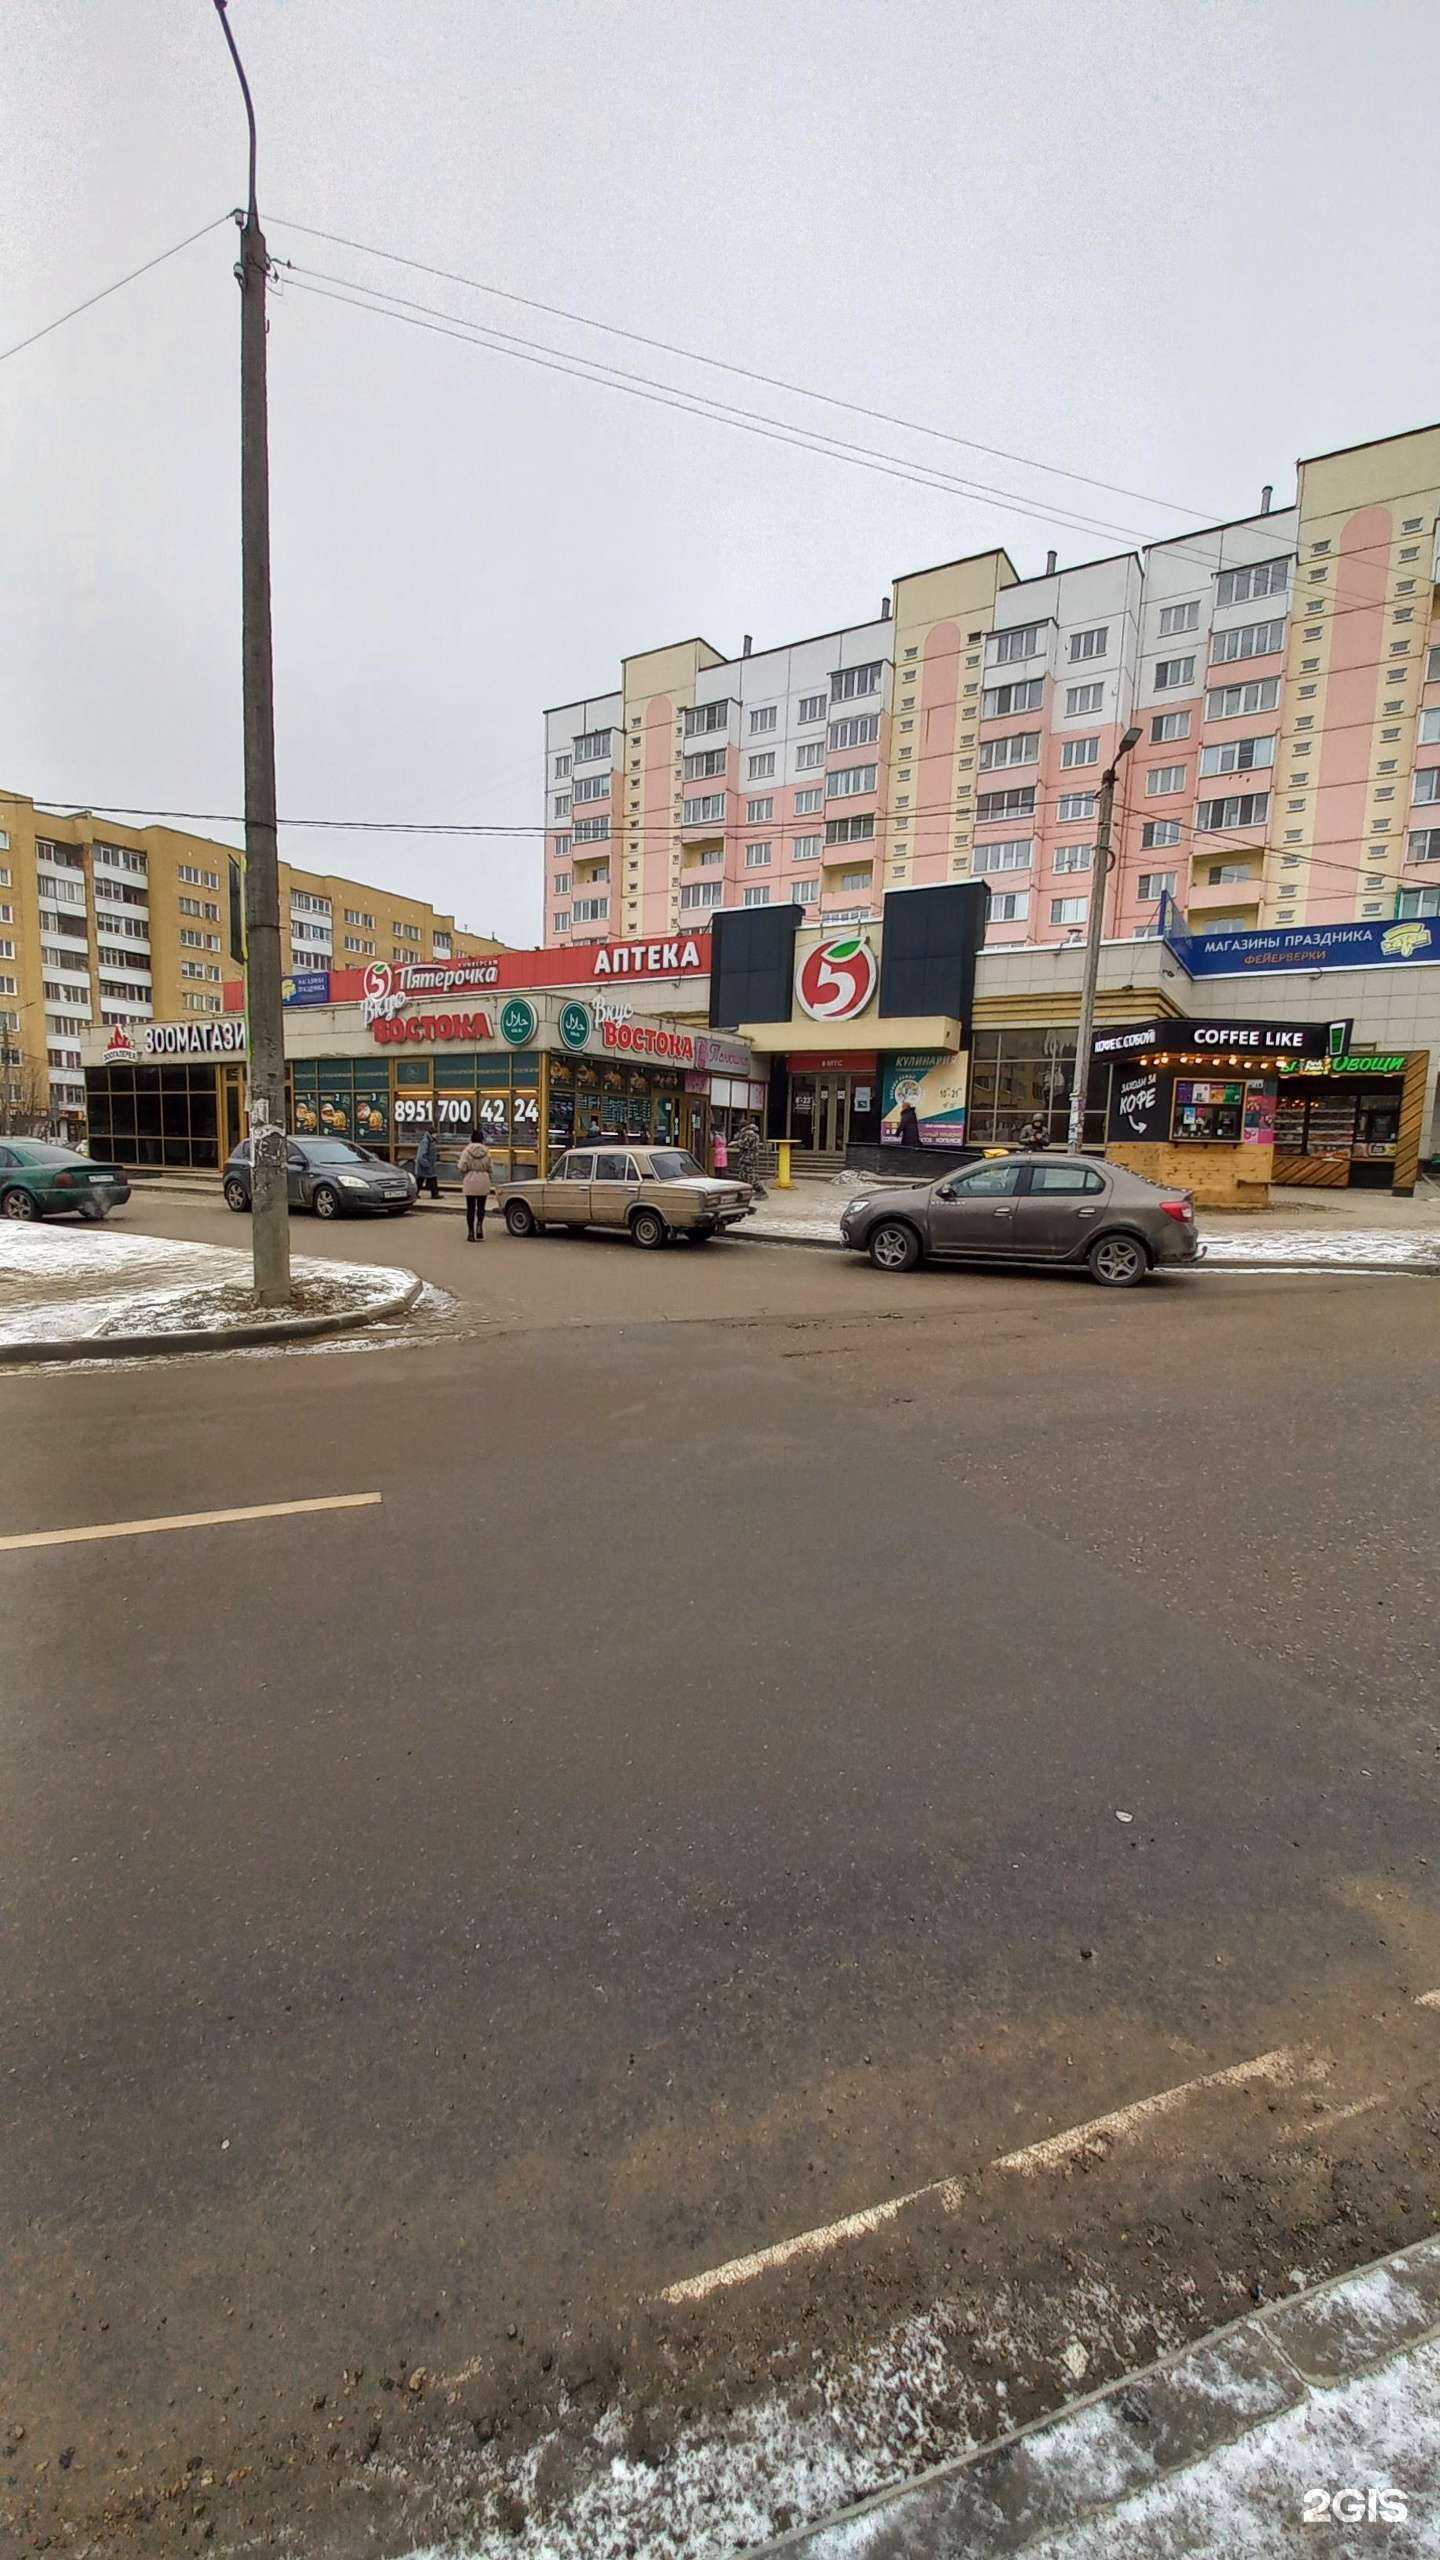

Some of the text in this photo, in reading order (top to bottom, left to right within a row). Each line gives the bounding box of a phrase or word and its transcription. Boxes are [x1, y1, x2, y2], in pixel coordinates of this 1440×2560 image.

[1204, 937, 1280, 953] МАГАЗИНЫ
[1284, 929, 1373, 948] ПРАЗДНИКА
[593, 941, 700, 975] АПТЕКА
[1243, 950, 1327, 966] ФЕЙЕРВЕРКИ
[811, 961, 856, 1017] 5
[361, 991, 406, 1027] Вкус
[591, 995, 634, 1030] Вкус
[144, 1022, 247, 1053] ЗООМАГАЗИ
[372, 1012, 494, 1045] ВОСТОКА
[602, 1022, 695, 1061] ВОСТОКА
[1094, 1039, 1116, 1053] КОФЕ
[1123, 1028, 1156, 1048] СОБОЙ
[1193, 1029, 1304, 1047] COFFEE LIKE
[895, 1055, 961, 1067] КУЛИНАРИЯ
[394, 1099, 433, 1122] 8951
[437, 1099, 472, 1123] 700
[480, 1099, 505, 1122] 42
[513, 1098, 539, 1122] 24
[1119, 1087, 1156, 1115] КОФЕ
